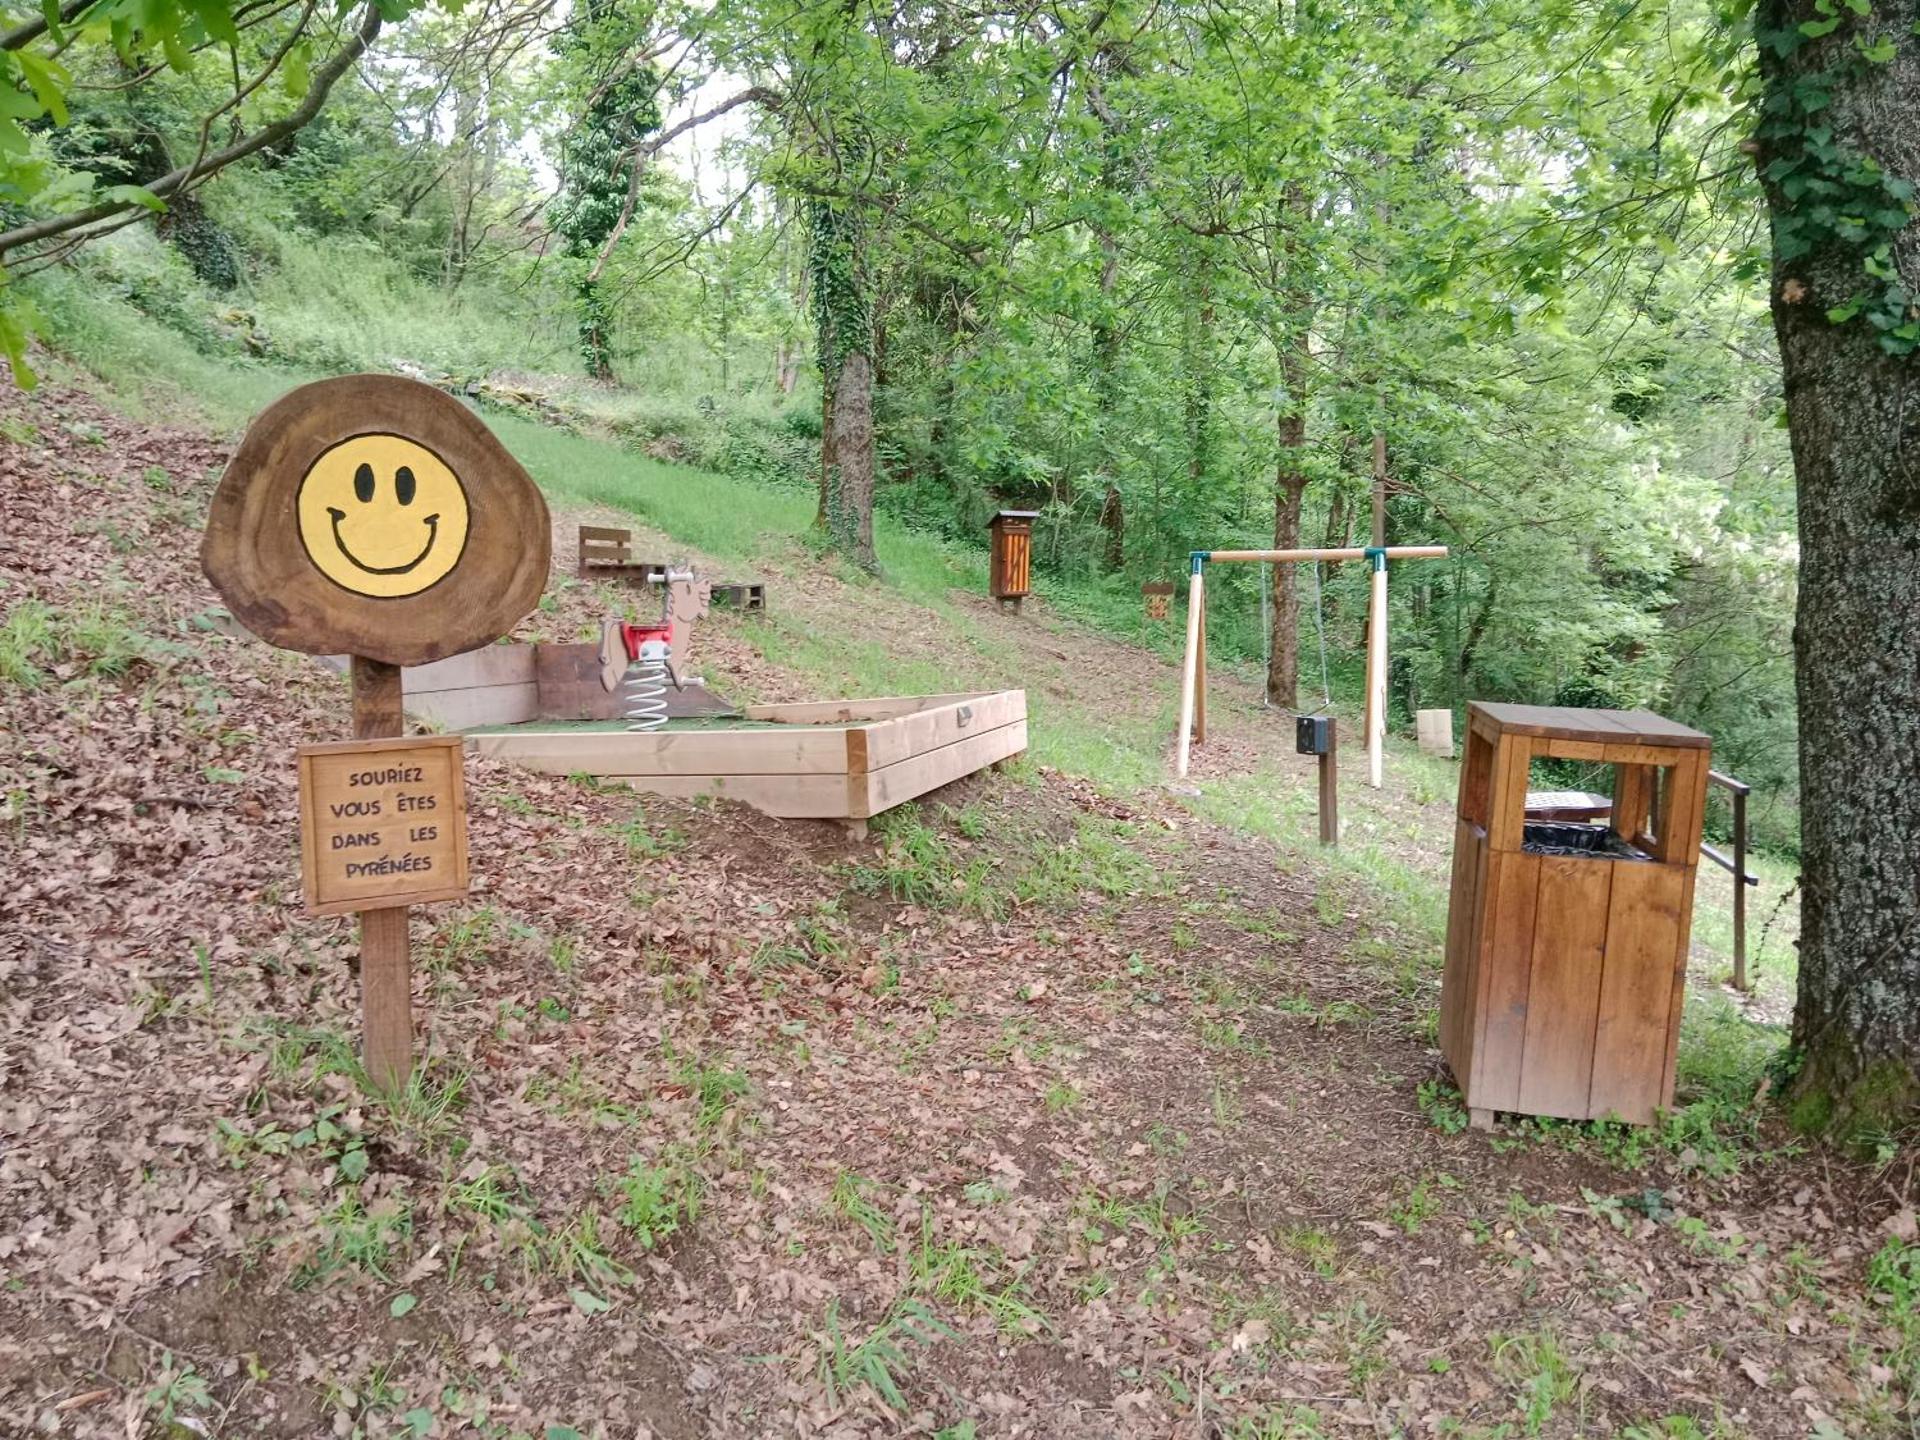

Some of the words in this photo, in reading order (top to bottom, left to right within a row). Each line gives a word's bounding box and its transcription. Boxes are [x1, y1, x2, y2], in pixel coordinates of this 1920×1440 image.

[330, 800, 381, 818] VOUS
[396, 792, 436, 812] ÊTES
[332, 832, 380, 850] DANS
[410, 826, 437, 843] LES
[346, 852, 432, 878] PYRÉNÉES
